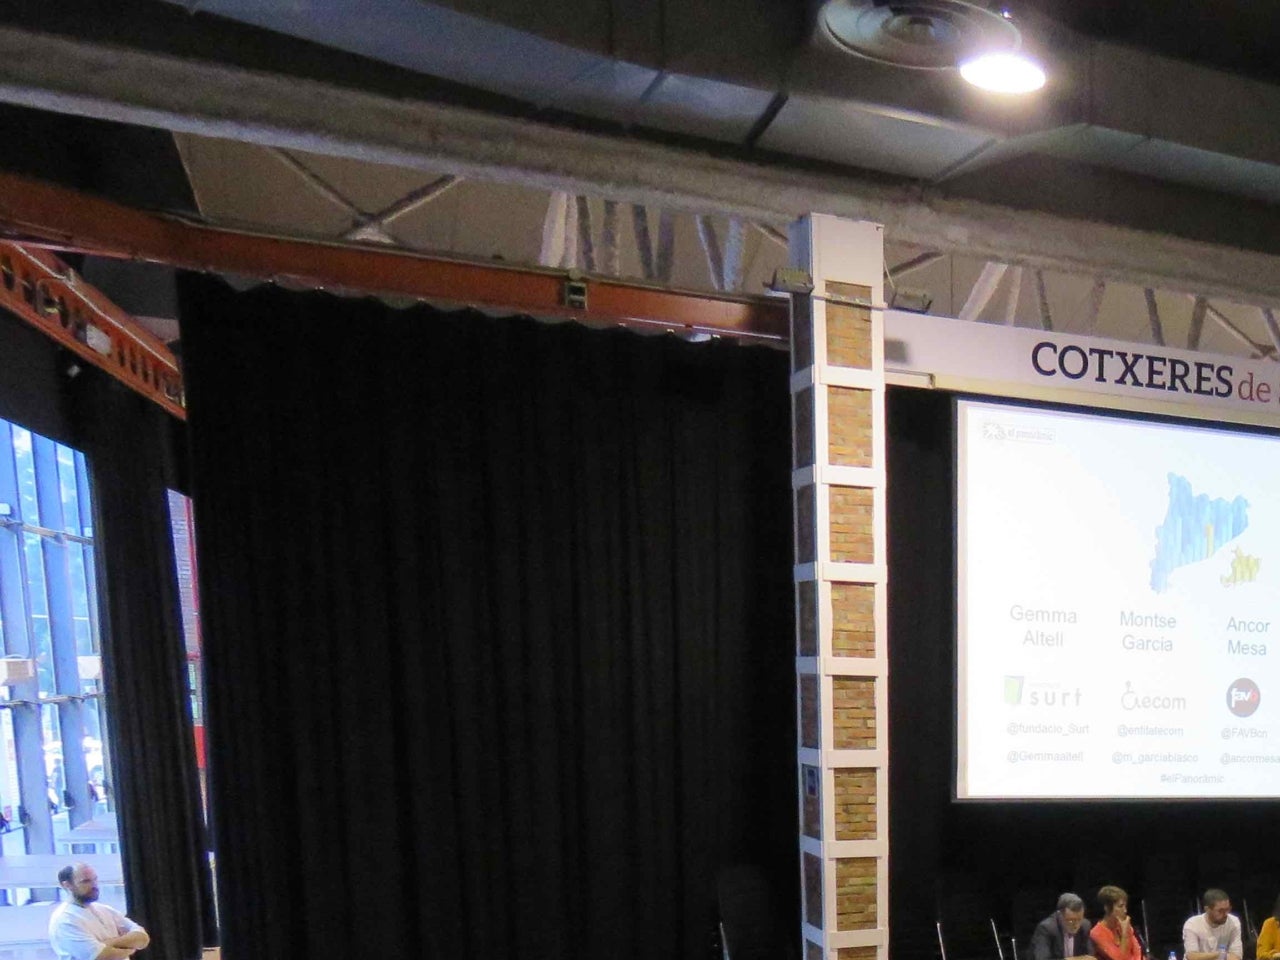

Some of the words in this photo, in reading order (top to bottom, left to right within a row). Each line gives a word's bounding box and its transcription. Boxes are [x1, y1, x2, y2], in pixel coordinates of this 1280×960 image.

[1031, 341, 1234, 398] COTXERES
[1238, 371, 1272, 403] de
[1009, 604, 1078, 624] Gemma
[1120, 610, 1177, 629] Montse
[1226, 616, 1271, 633] Ancor
[1022, 629, 1064, 647] Altell
[1227, 639, 1267, 656] Mesa
[1029, 687, 1083, 707] surt
[1141, 695, 1187, 711] ecom
